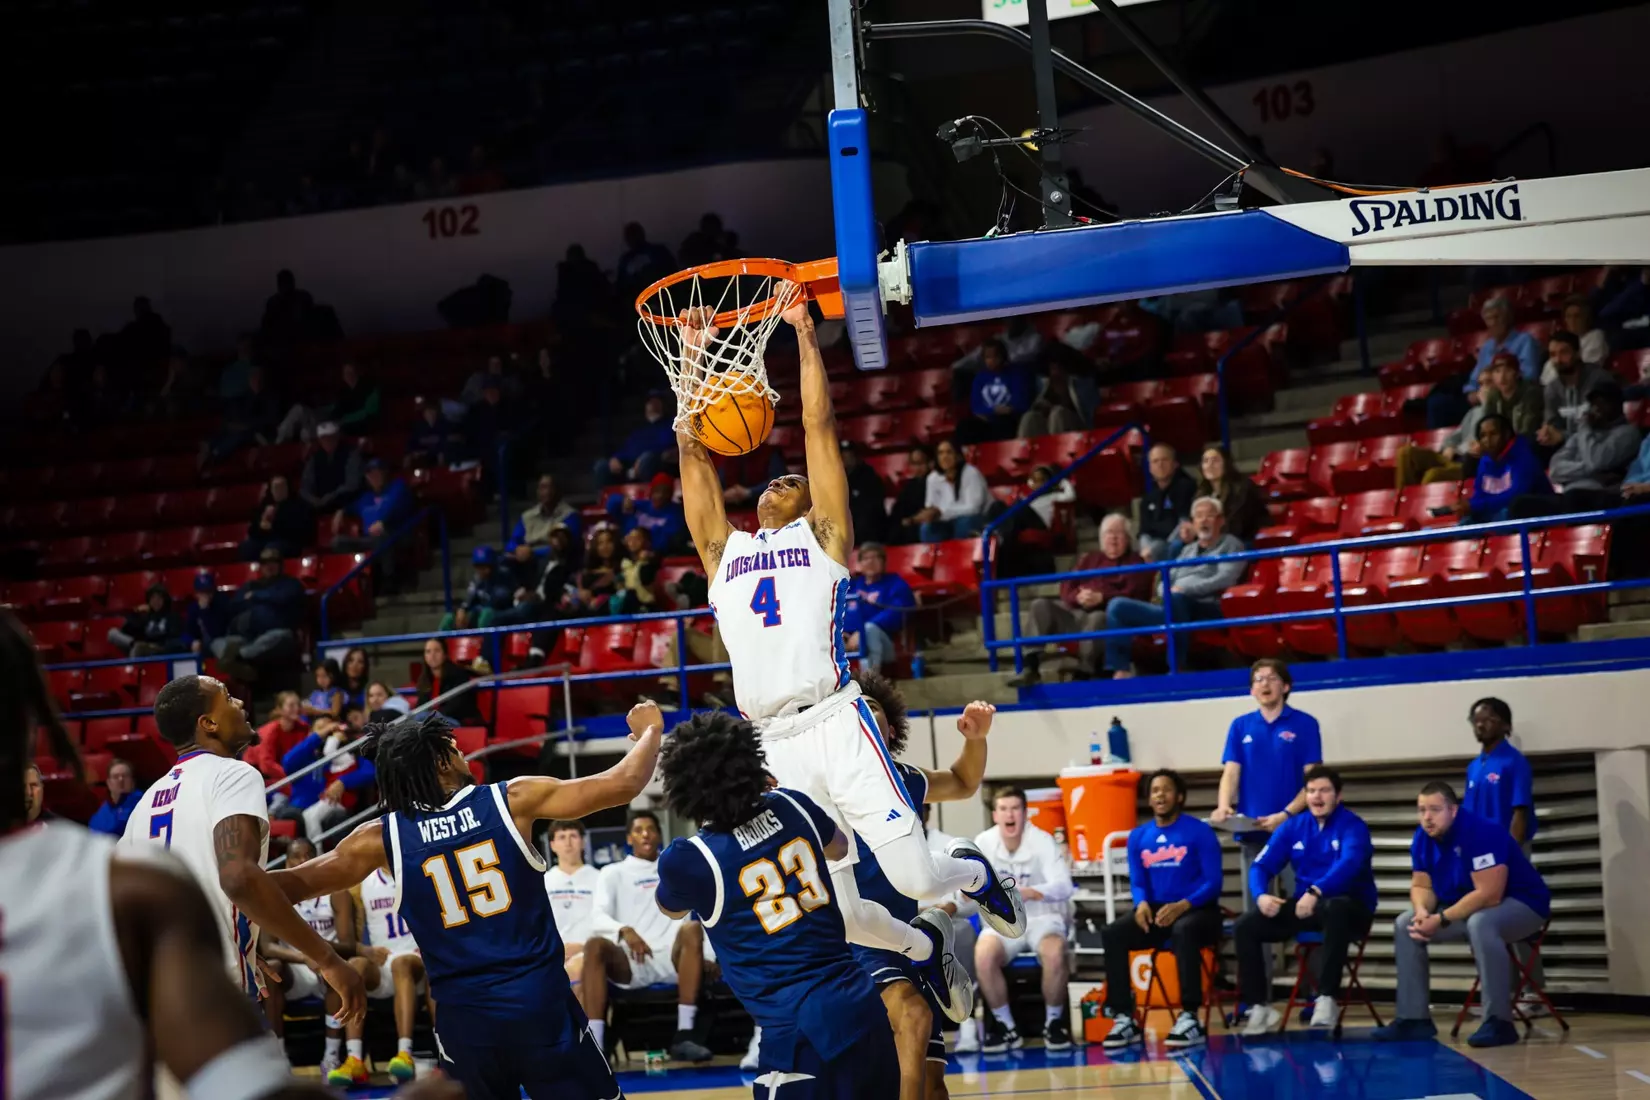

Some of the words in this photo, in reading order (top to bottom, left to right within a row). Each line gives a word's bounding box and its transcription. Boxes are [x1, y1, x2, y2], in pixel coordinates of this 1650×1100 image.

[1253, 82, 1315, 123] 103
[422, 205, 480, 239] 102
[1350, 184, 1522, 236] SPALDING
[725, 550, 777, 583] LOUISIANA
[777, 548, 811, 569] TECH
[750, 576, 782, 628] 4
[149, 808, 174, 852] 7
[417, 815, 457, 843] WEST
[458, 806, 482, 833] JR.
[732, 808, 784, 851] BROOKS
[422, 838, 512, 929] 15
[738, 836, 830, 935] 23
[1130, 954, 1153, 991] G
